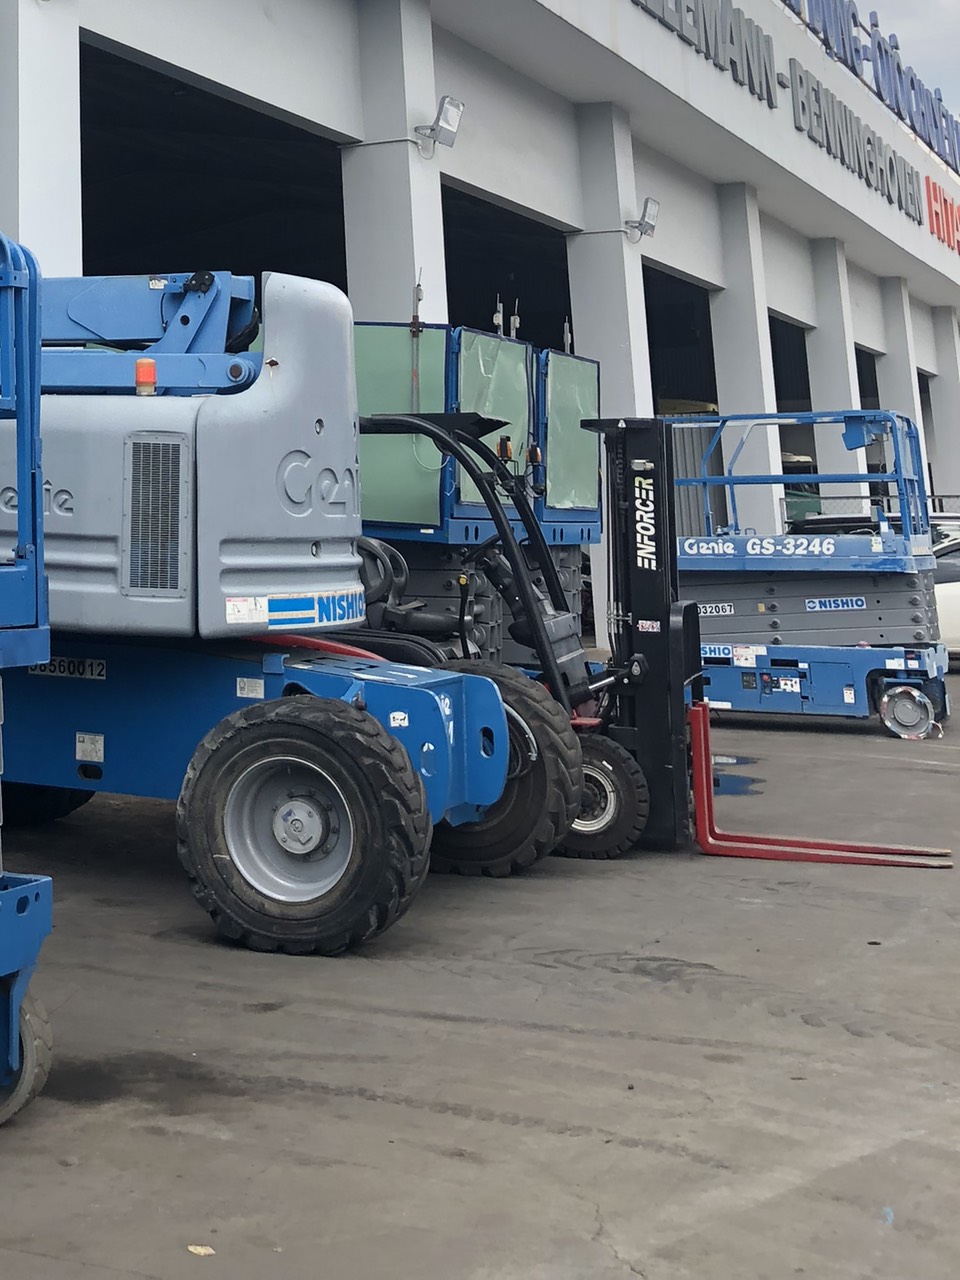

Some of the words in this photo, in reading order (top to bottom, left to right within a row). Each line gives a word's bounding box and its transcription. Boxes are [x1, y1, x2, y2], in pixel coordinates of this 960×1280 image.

[789, 57, 924, 226] BENNINGHOVEN
[635, 476, 657, 570] ENFORCER
[684, 539, 736, 555] Genie
[746, 537, 836, 555] GS-3246
[818, 597, 865, 610] NISHIO
